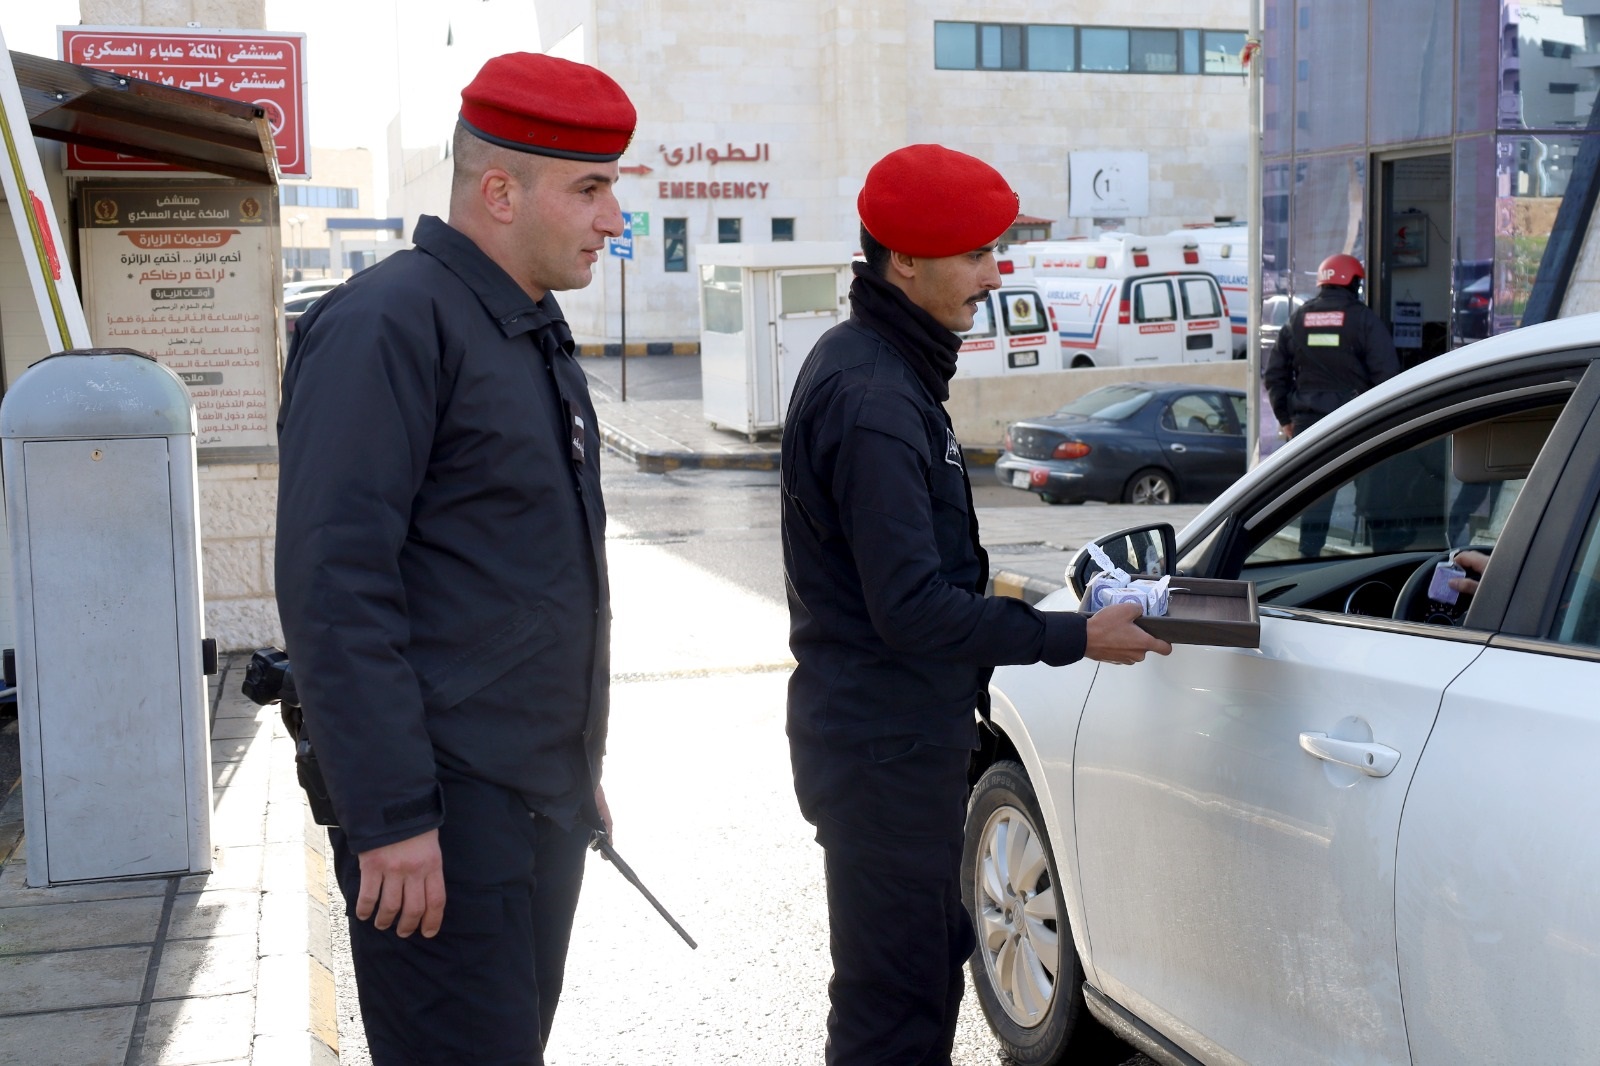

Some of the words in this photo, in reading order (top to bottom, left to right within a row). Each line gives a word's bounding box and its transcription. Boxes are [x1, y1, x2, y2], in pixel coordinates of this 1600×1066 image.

[83, 40, 143, 60] العسكري
[150, 43, 184, 61] علياء
[188, 41, 221, 60] الملكة
[227, 41, 283, 63] مستشفى
[229, 71, 286, 92] مستشفى
[659, 142, 770, 166] الطوارئ
[659, 181, 770, 199] EMERGENCY
[156, 195, 200, 207] مستشفى
[128, 210, 170, 223] العسكري
[172, 210, 196, 221] علياء
[198, 209, 229, 219] الملكة
[139, 234, 171, 247] الزيارة
[174, 233, 221, 246] تعليمات
[121, 253, 150, 265] الزائرة
[153, 251, 180, 265] أختي
[194, 253, 216, 264] الزائر
[219, 250, 241, 264] أخي
[139, 269, 191, 285] مرضاكم
[195, 268, 225, 283] لراحة
